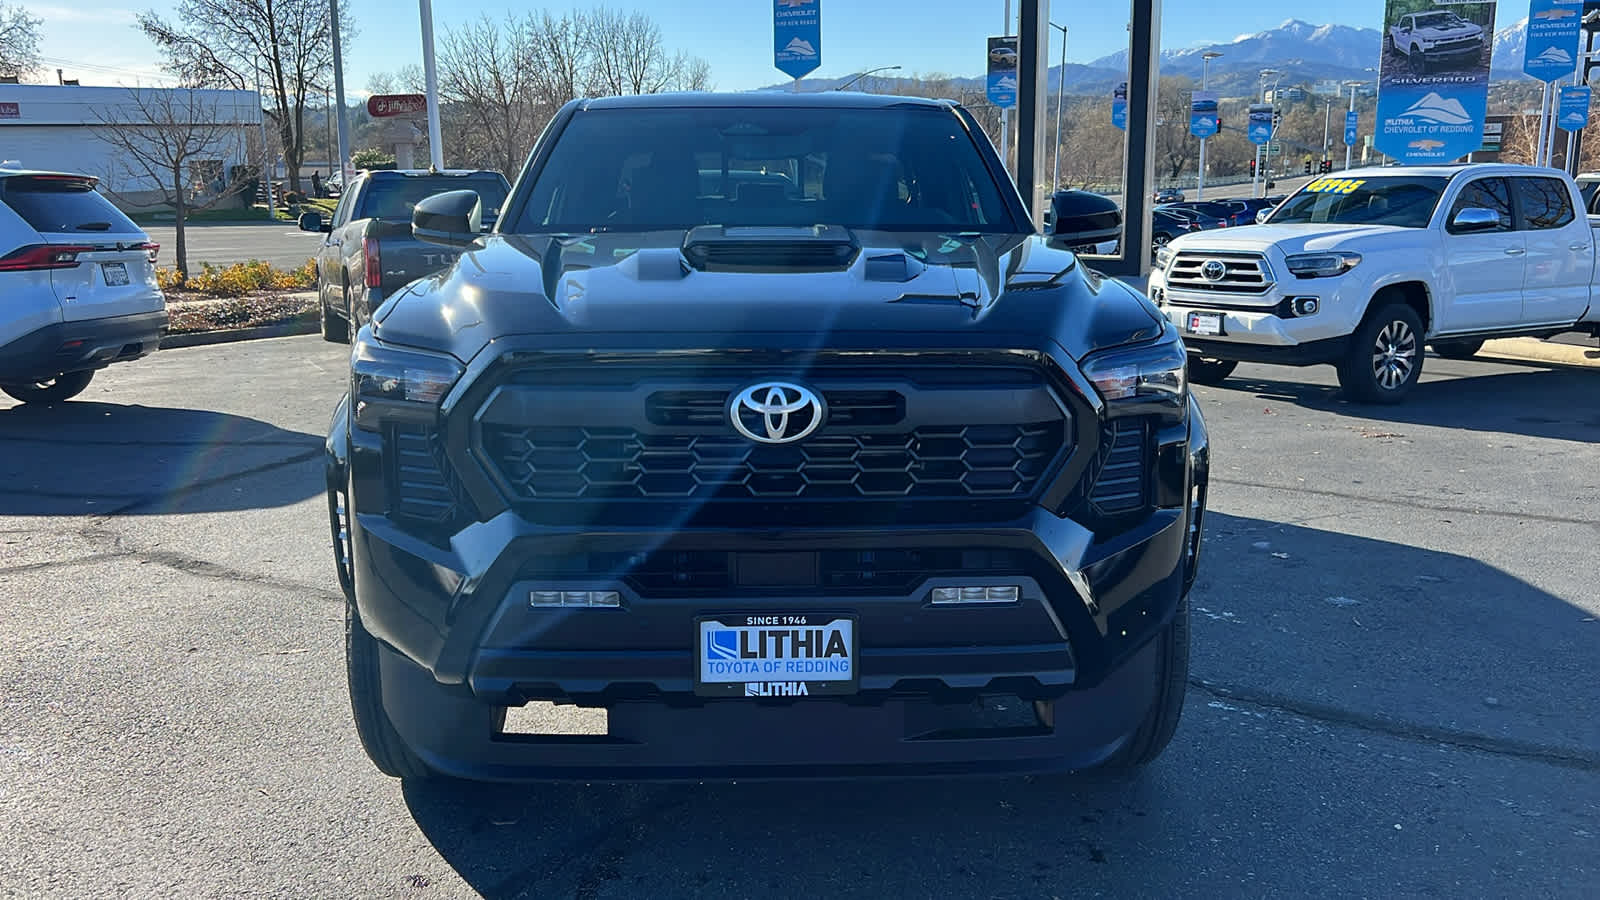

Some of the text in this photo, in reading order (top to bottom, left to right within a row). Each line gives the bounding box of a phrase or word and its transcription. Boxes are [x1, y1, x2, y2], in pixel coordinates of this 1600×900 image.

[1392, 76, 1475, 84] SILVERADO
[1391, 117, 1415, 126] LITHIA
[1384, 125, 1473, 134] CHEVROLET OF REDDING
[746, 615, 808, 626] SINCE 1946
[740, 630, 848, 659] LITHIA
[707, 660, 850, 675] TOYOTA OF REDDING
[759, 682, 808, 696] LITHIA
